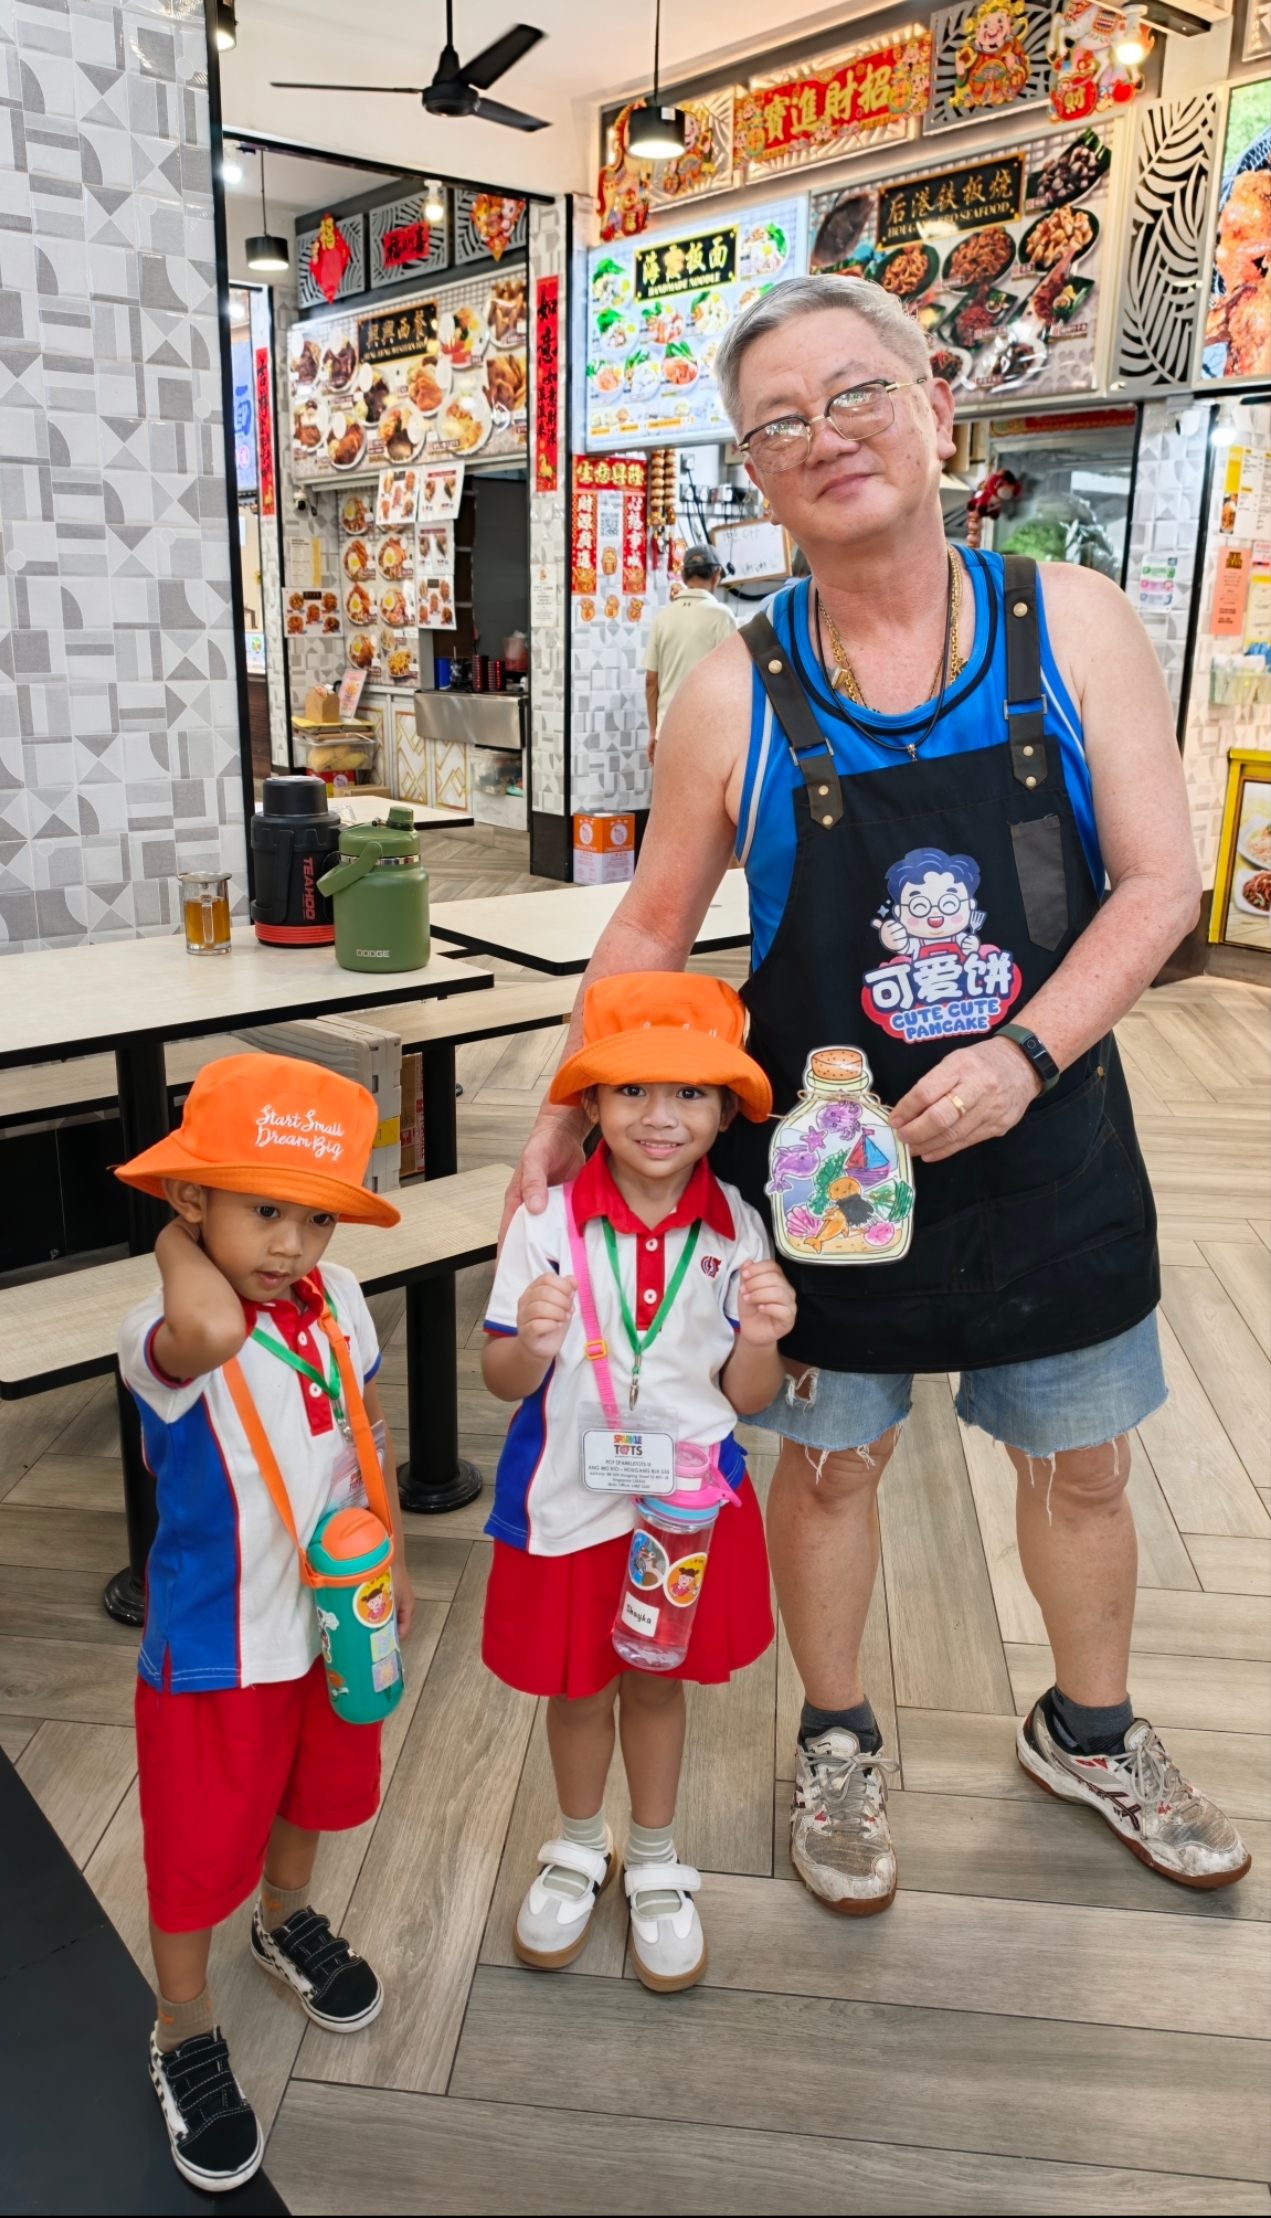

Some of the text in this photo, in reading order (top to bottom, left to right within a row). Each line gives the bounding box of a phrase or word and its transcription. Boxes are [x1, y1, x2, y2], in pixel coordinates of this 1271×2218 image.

[959, 201, 1011, 219] SEAFOOD
[688, 271, 721, 288] NOODLE
[303, 857, 316, 920] TEAHOO
[356, 948, 390, 958] DODGE
[865, 951, 1012, 1010] 可爱饼
[892, 998, 999, 1029] CUTE CUTE
[906, 1016, 988, 1039] PANCAKE
[255, 1104, 344, 1137] Start Small
[255, 1125, 344, 1162] Dream Big
[614, 1435, 642, 1444] SPARKLE
